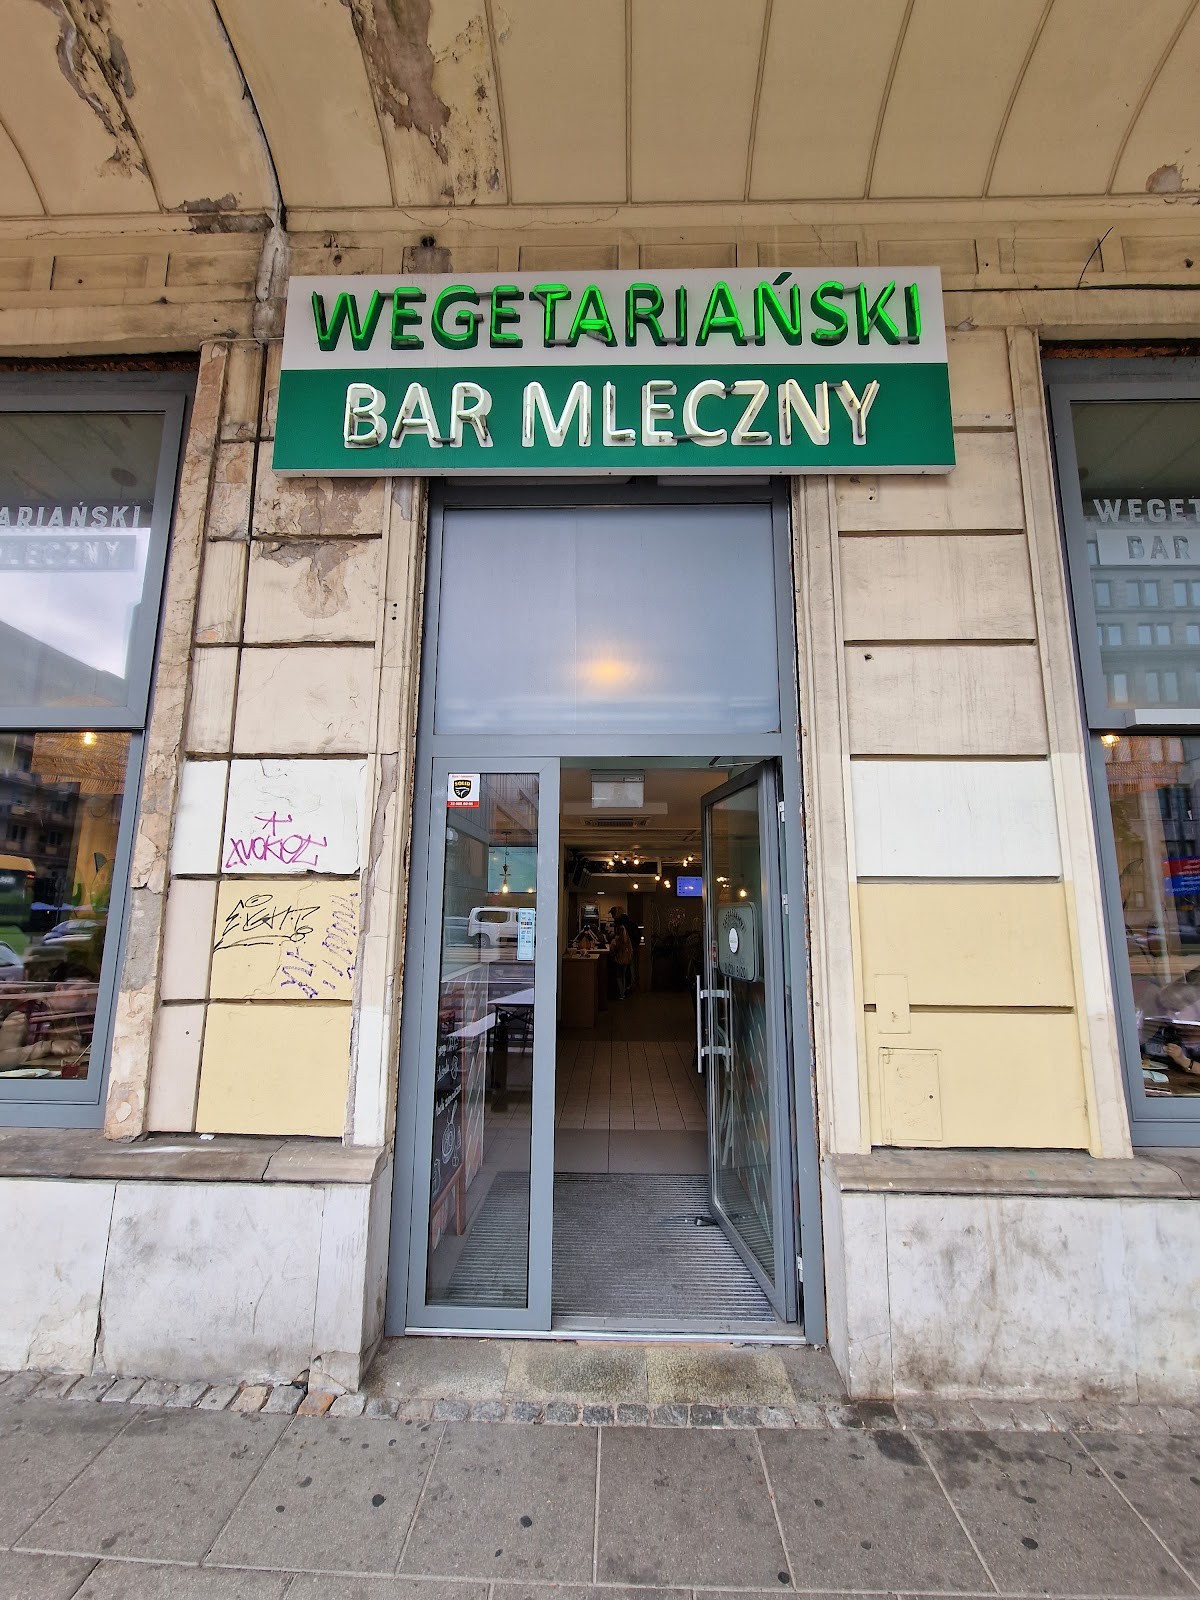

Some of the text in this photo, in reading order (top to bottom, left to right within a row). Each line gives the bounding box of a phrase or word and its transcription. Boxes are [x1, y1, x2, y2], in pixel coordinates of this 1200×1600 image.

[312, 272, 921, 351] WEGETARIAŃSKI
[344, 379, 881, 449] BAR MLECZNY
[0, 541, 120, 566] LECZNY
[1126, 535, 1191, 560] BAR
